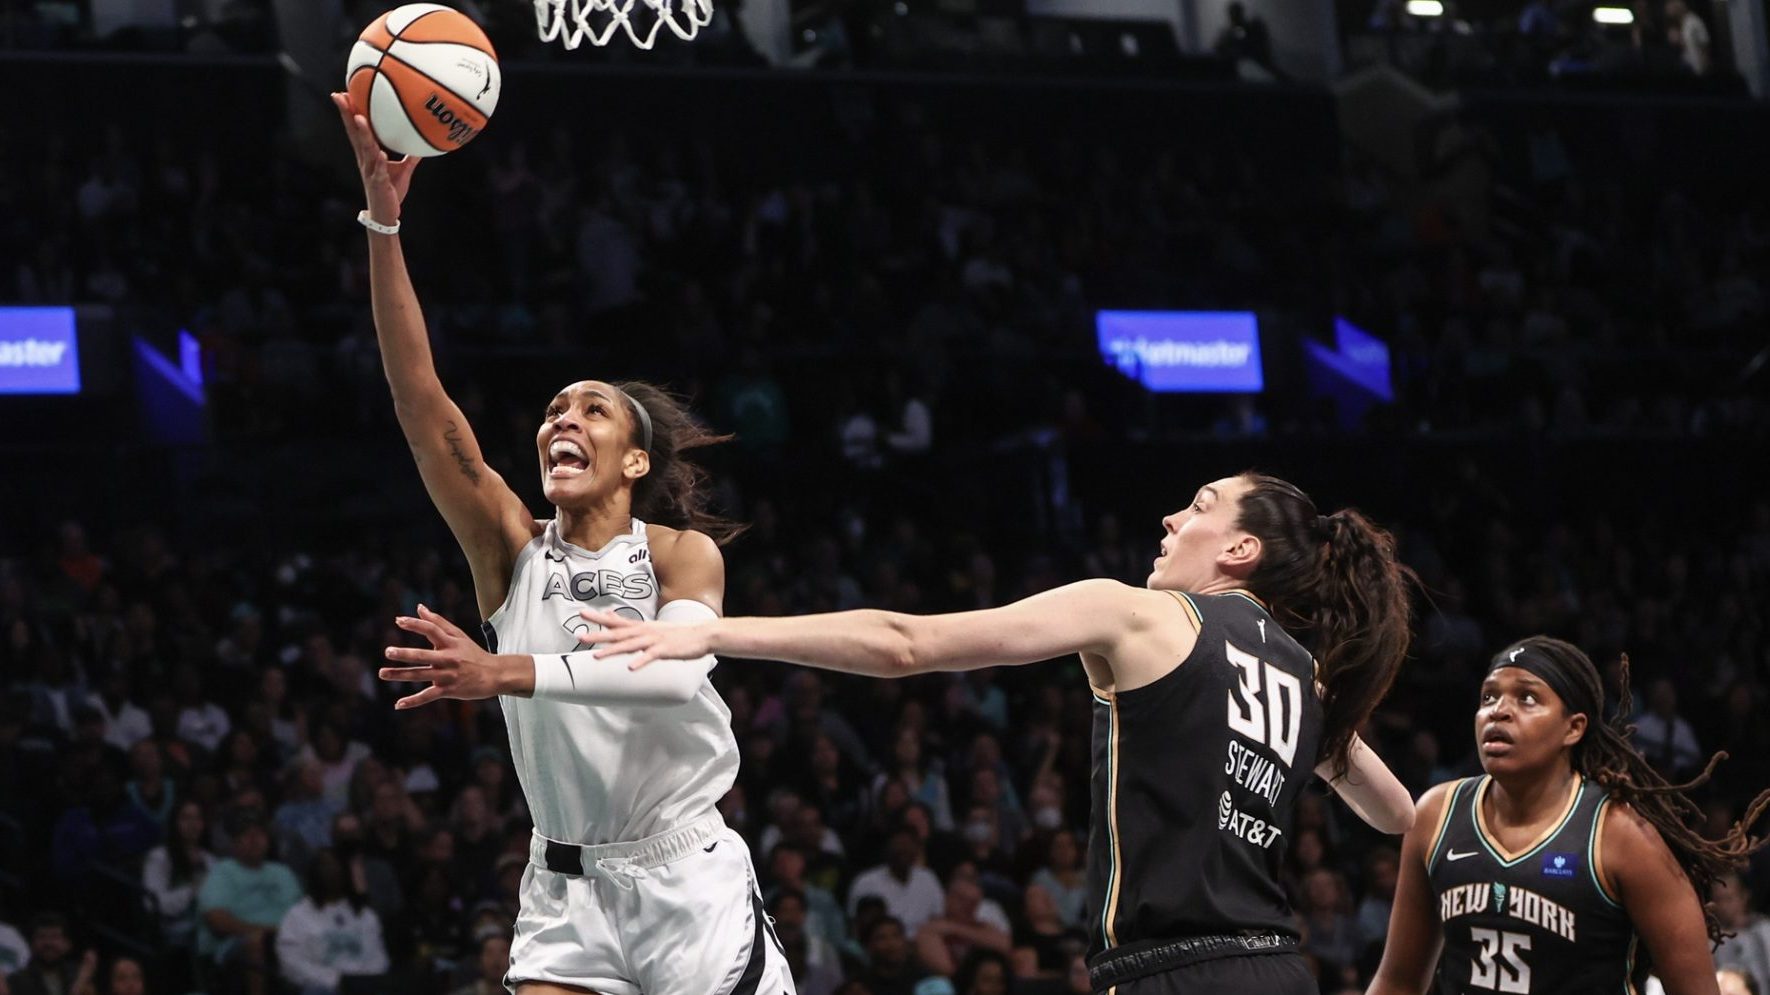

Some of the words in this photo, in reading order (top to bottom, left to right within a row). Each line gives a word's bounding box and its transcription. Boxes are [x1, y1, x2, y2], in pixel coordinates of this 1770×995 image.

[425, 93, 480, 145] ilson
[629, 549, 652, 563] all
[542, 569, 653, 601] ACES
[1225, 639, 1302, 769] 30
[1225, 740, 1285, 807] STEWART
[1228, 809, 1282, 848] AT&T
[1440, 882, 1491, 922] NEW
[1509, 885, 1576, 943] YORK
[1470, 926, 1531, 995] 35
